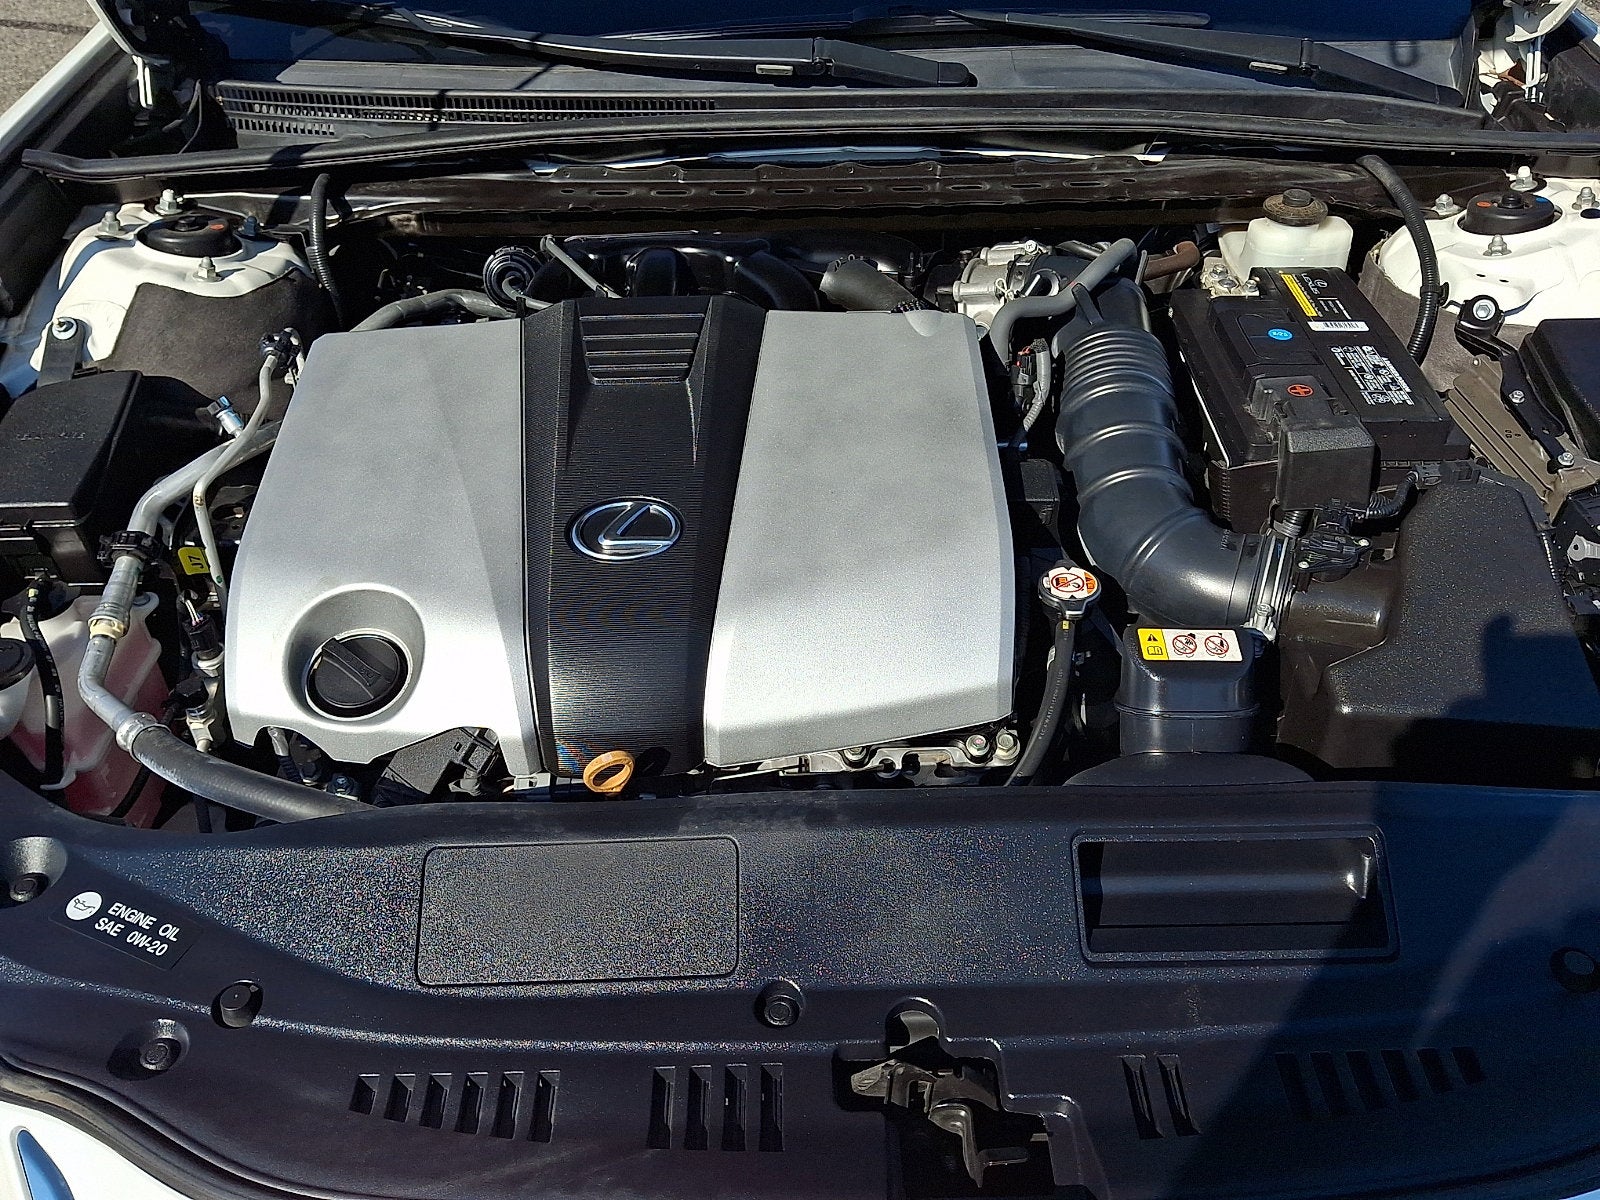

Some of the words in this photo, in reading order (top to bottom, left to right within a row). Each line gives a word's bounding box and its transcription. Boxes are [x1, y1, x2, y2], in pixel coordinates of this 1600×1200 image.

[1301, 273, 1321, 295] LEXUS
[187, 554, 205, 570] J7
[94, 917, 126, 937] SAE
[126, 930, 169, 956] 0W-20
[107, 901, 158, 930] ENGINE
[158, 923, 180, 942] OIL
